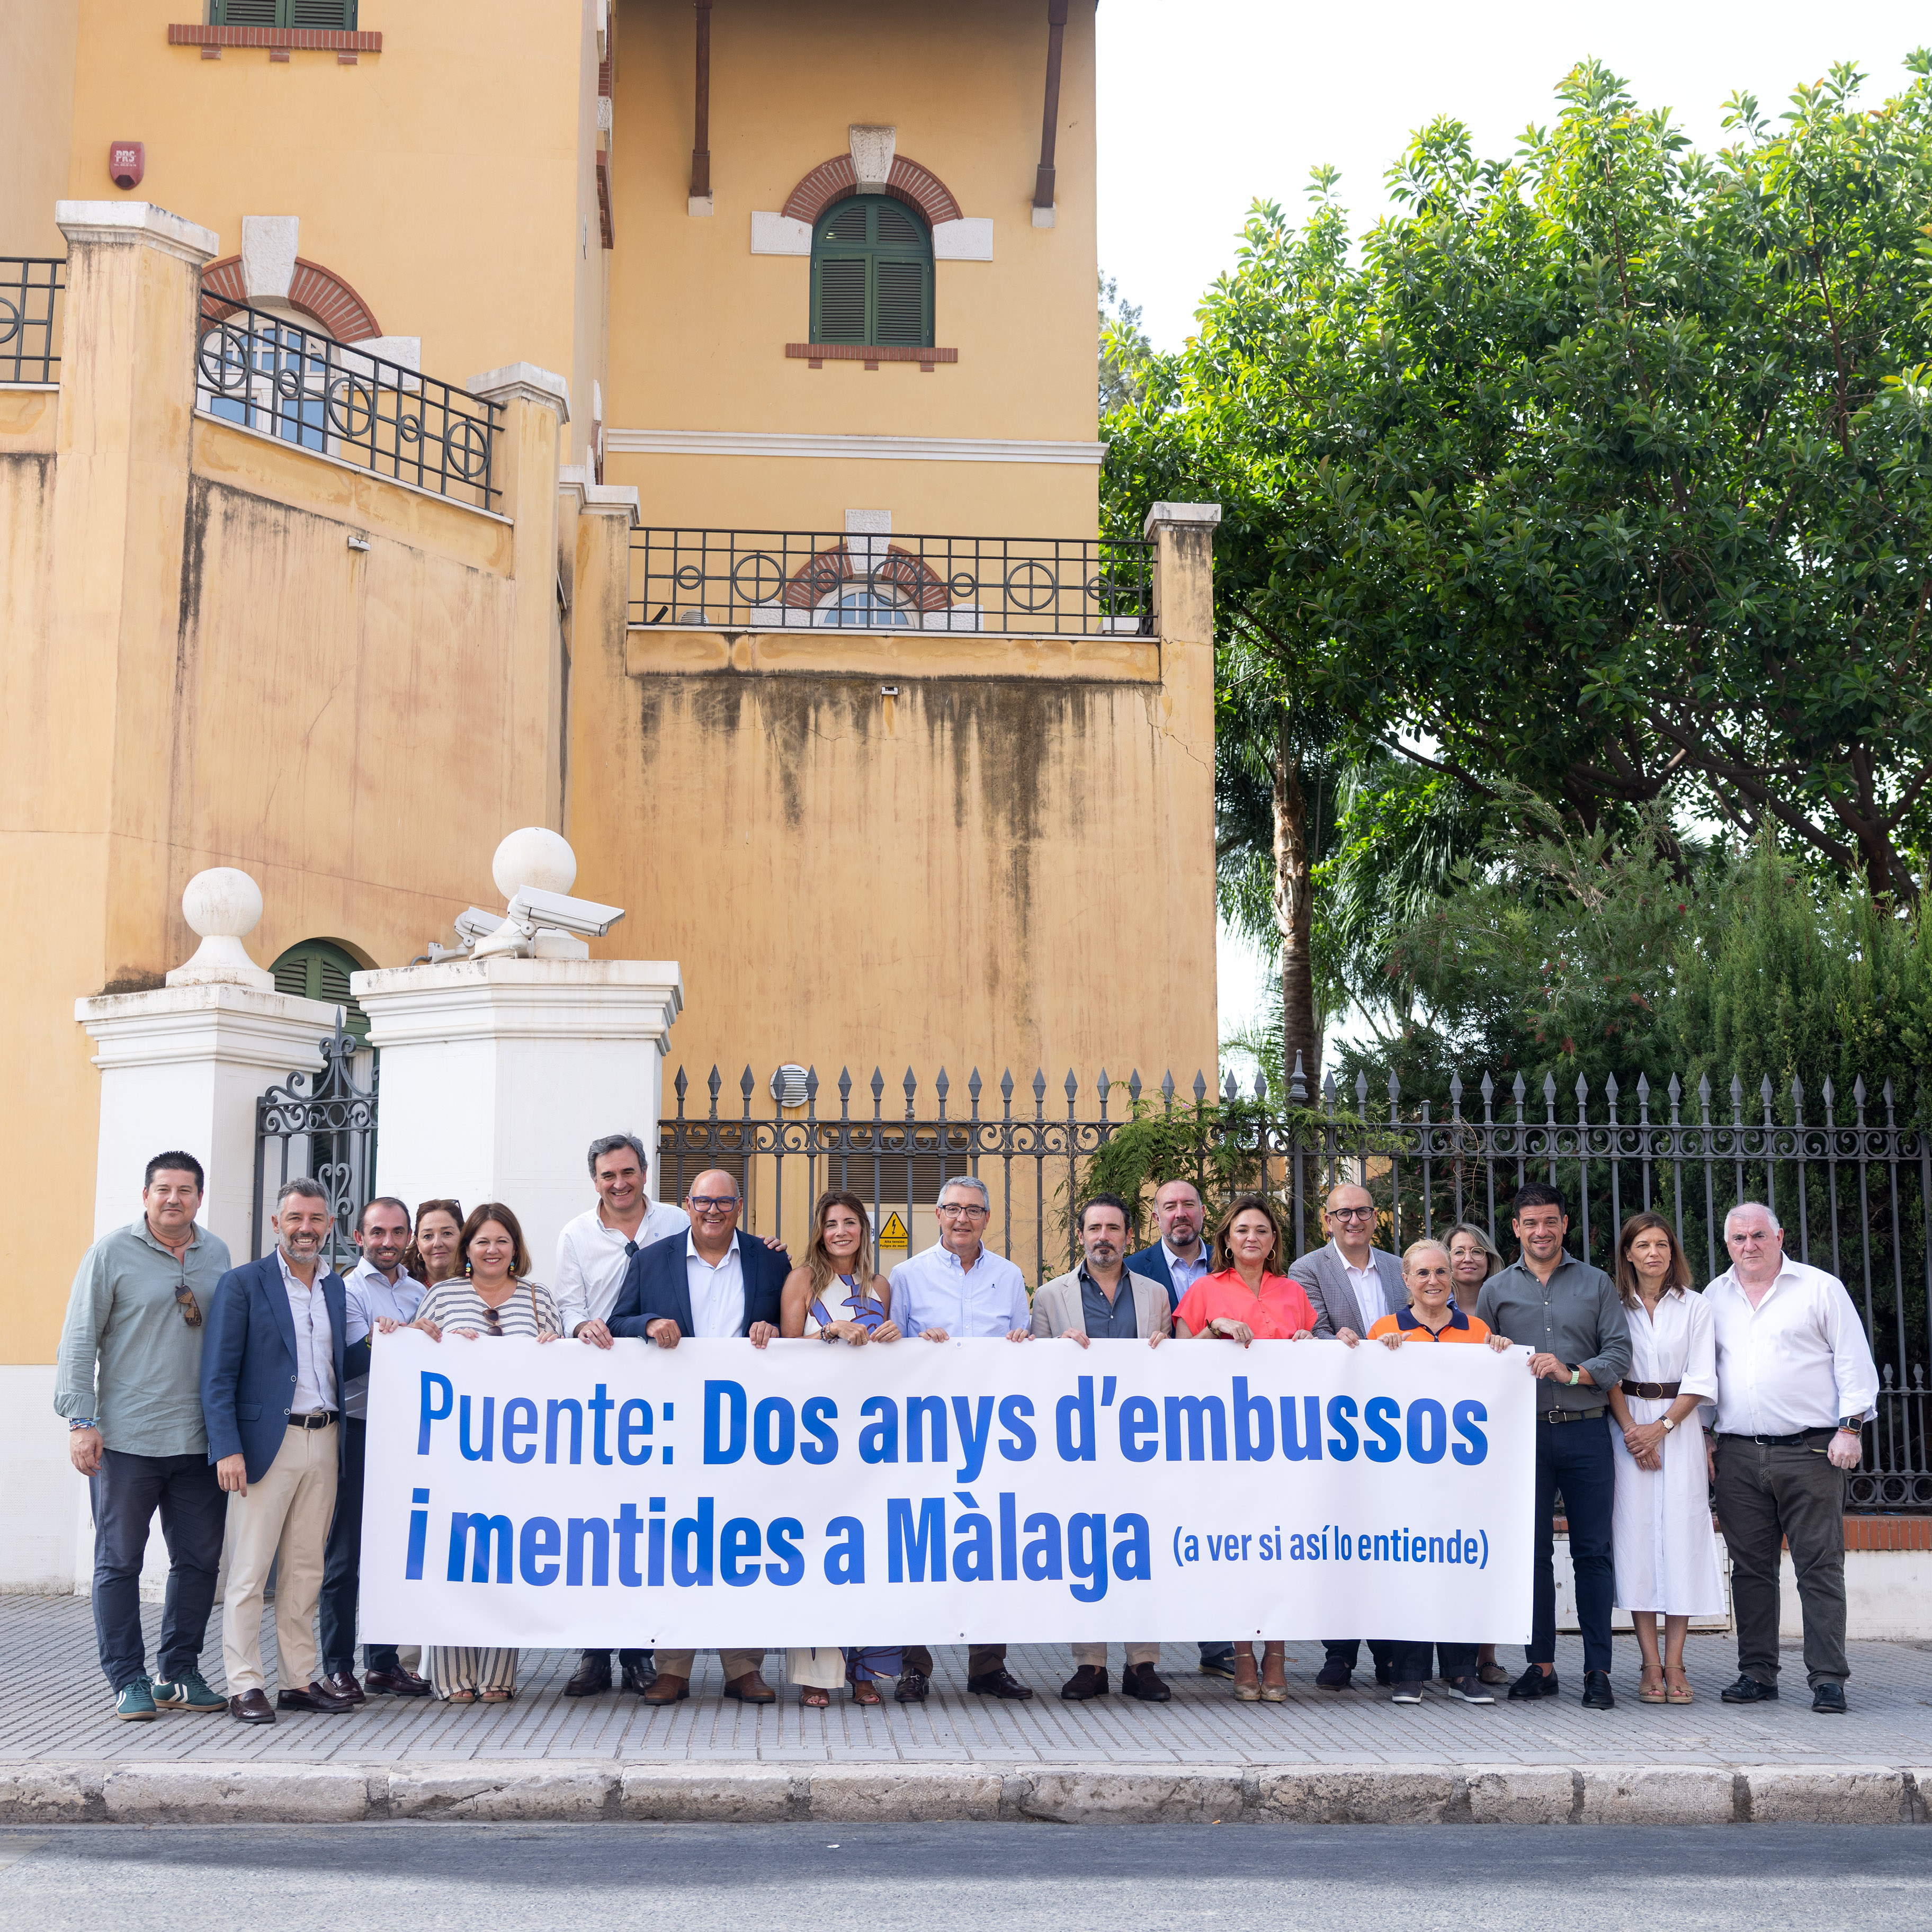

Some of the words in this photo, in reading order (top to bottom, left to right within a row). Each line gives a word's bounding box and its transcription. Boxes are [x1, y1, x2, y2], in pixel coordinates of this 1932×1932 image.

[116, 150, 135, 162] PRS
[417, 1371, 674, 1466] Puente:
[703, 1380, 838, 1465] Dos
[858, 1396, 1036, 1483] anys
[1056, 1375, 1488, 1466] d’embussos
[405, 1488, 430, 1580] i
[446, 1497, 805, 1587] mentides
[824, 1516, 865, 1585] a
[887, 1491, 1151, 1603] Màlaga
[1173, 1526, 1199, 1567] (a
[1206, 1534, 1252, 1561] ver
[1259, 1525, 1282, 1561] si
[1290, 1525, 1330, 1561] así
[1334, 1525, 1352, 1561] lo
[1358, 1527, 1488, 1569] entiende)
